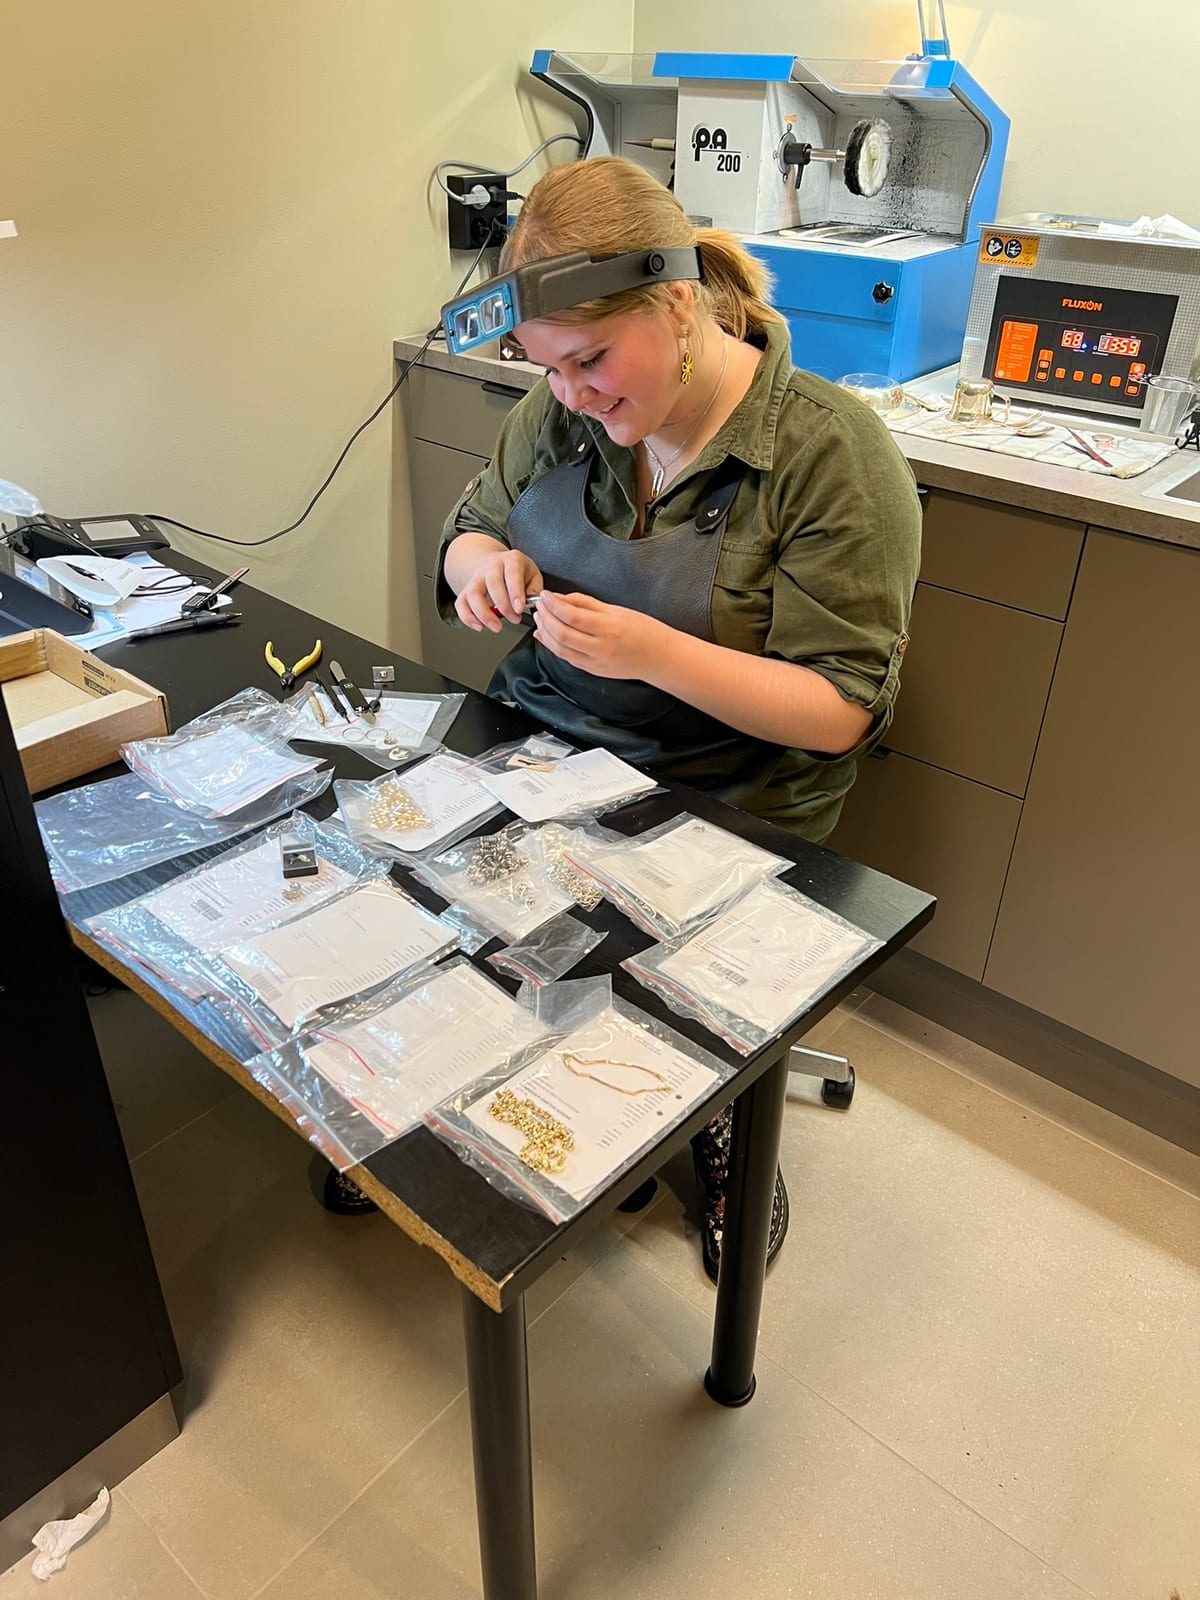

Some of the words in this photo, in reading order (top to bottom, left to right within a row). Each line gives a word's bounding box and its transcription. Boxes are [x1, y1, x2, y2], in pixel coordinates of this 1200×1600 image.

[717, 154, 741, 172] 200
[1062, 298, 1103, 311] FLUXON
[1063, 331, 1082, 346] 68
